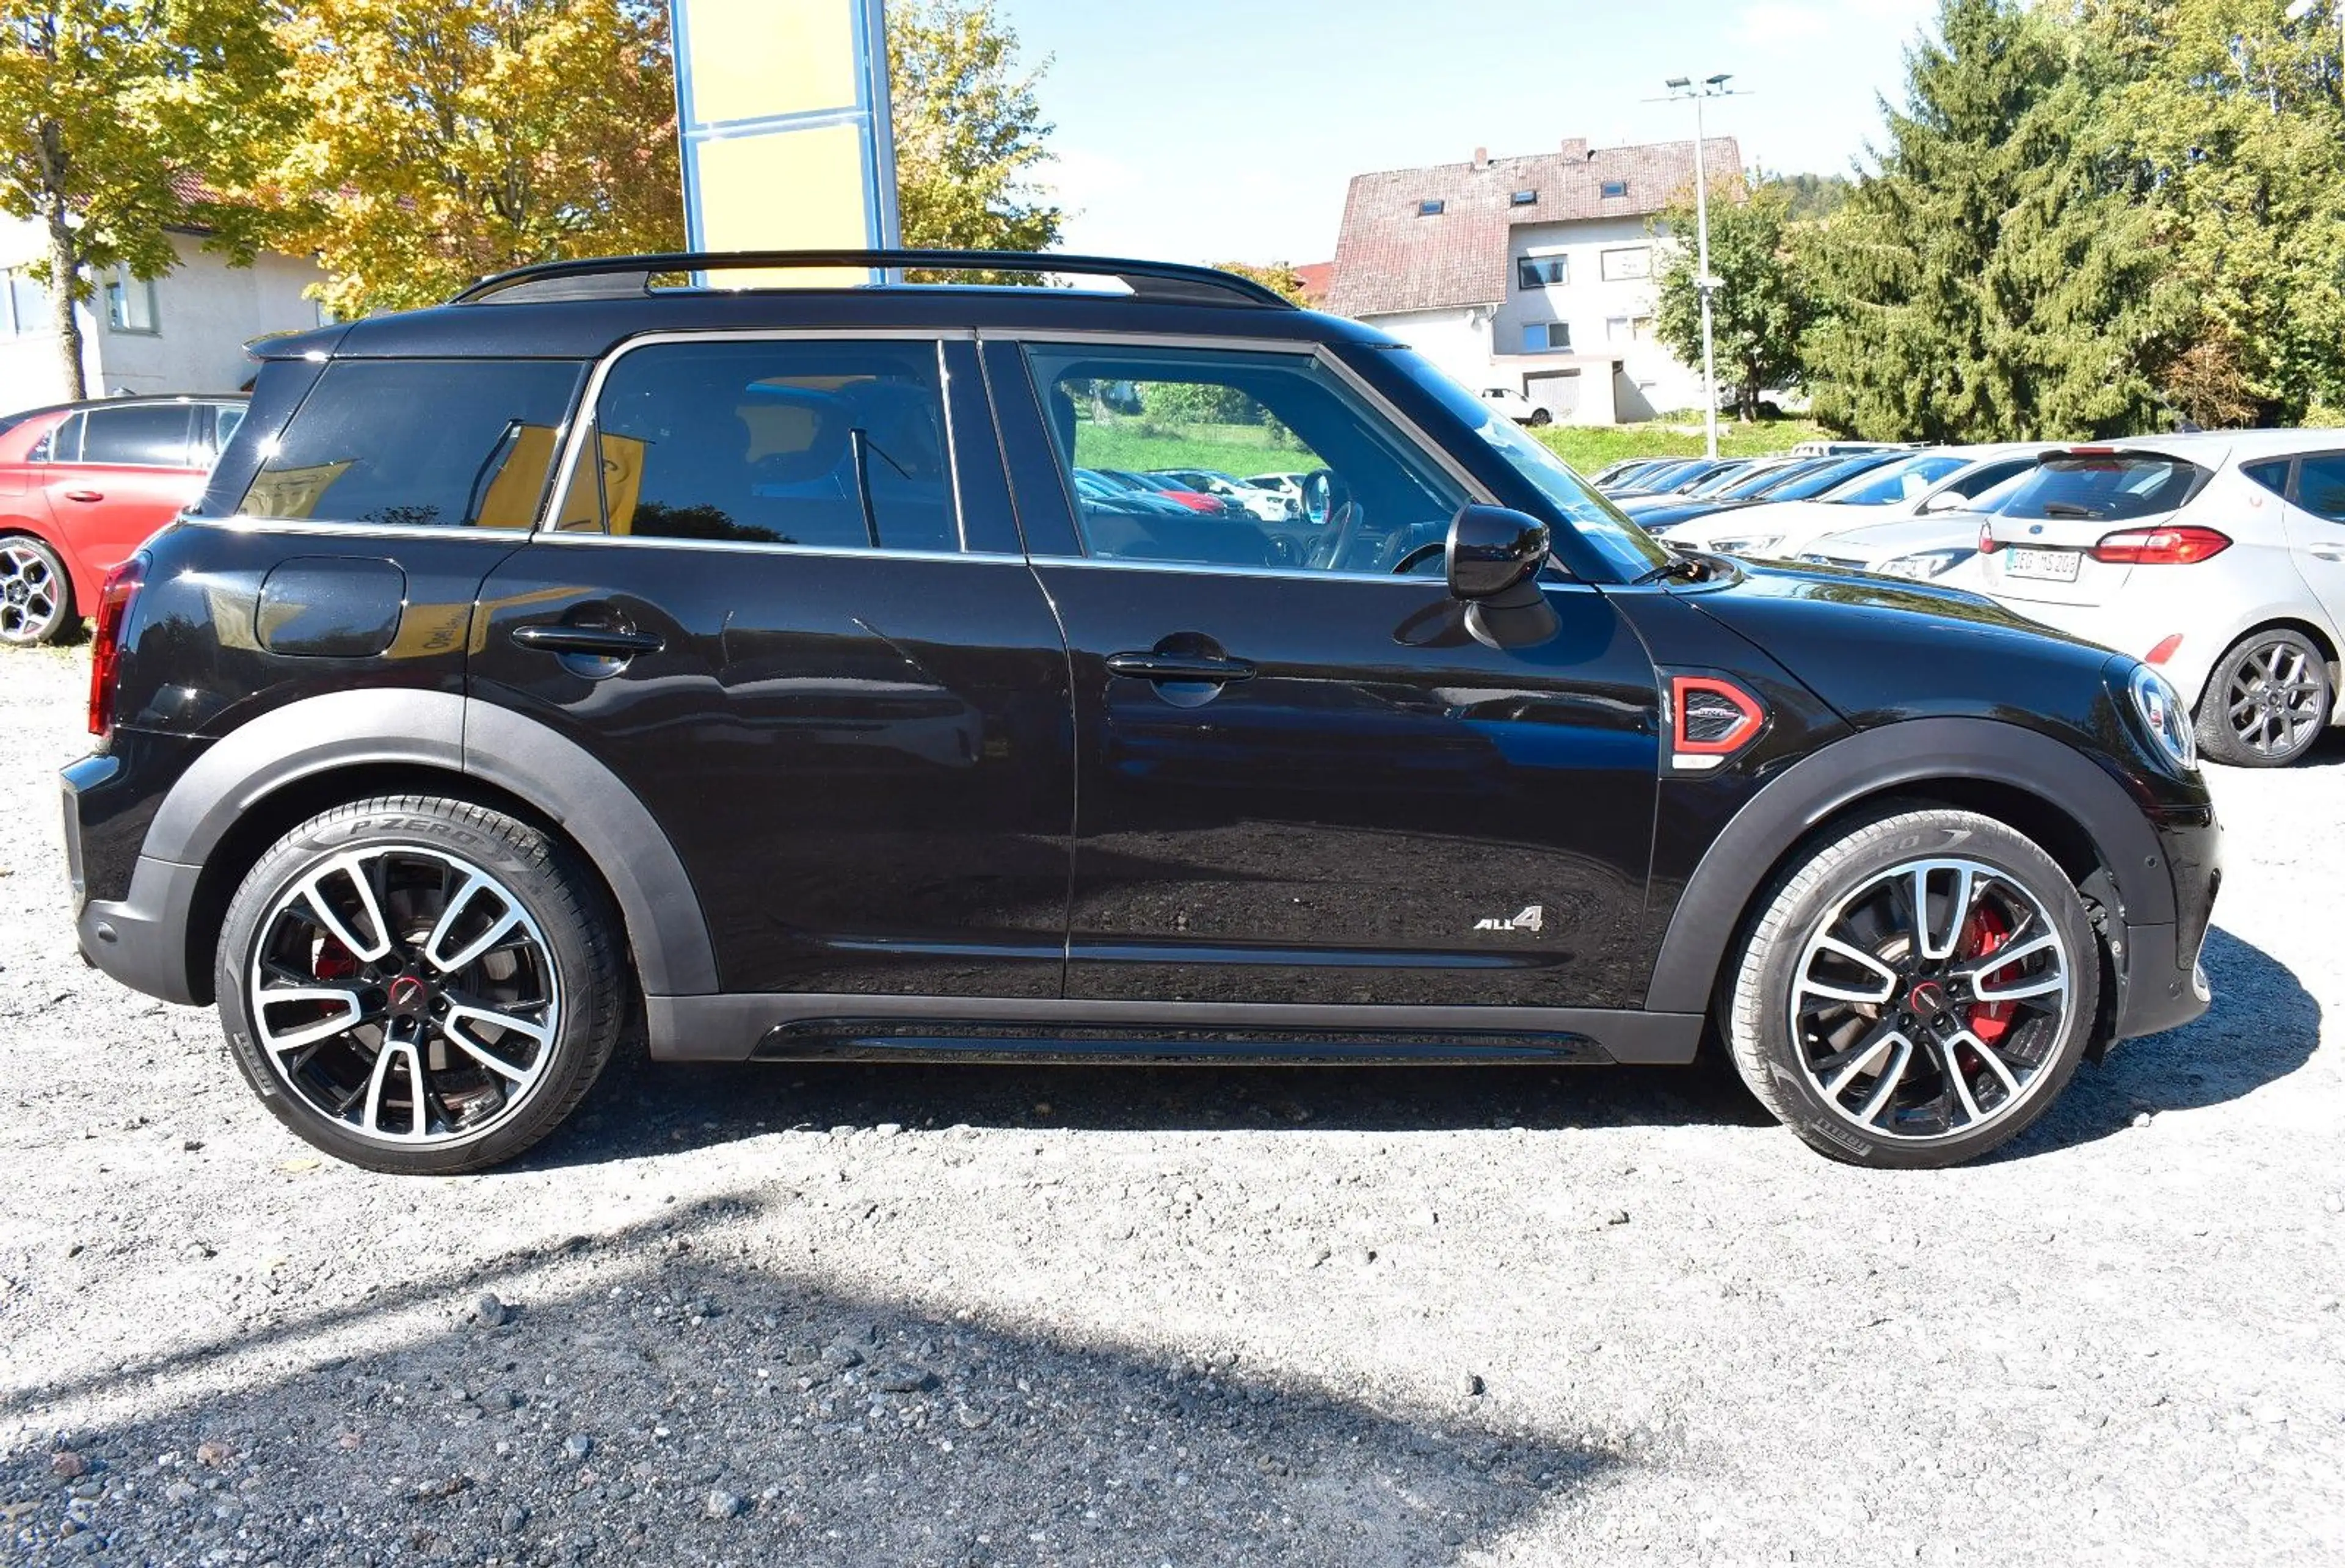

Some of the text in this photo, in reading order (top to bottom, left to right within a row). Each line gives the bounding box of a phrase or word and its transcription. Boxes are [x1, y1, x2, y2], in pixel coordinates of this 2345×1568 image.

[349, 818, 479, 846] P ZERO
[1473, 905, 1543, 932] ALL4
